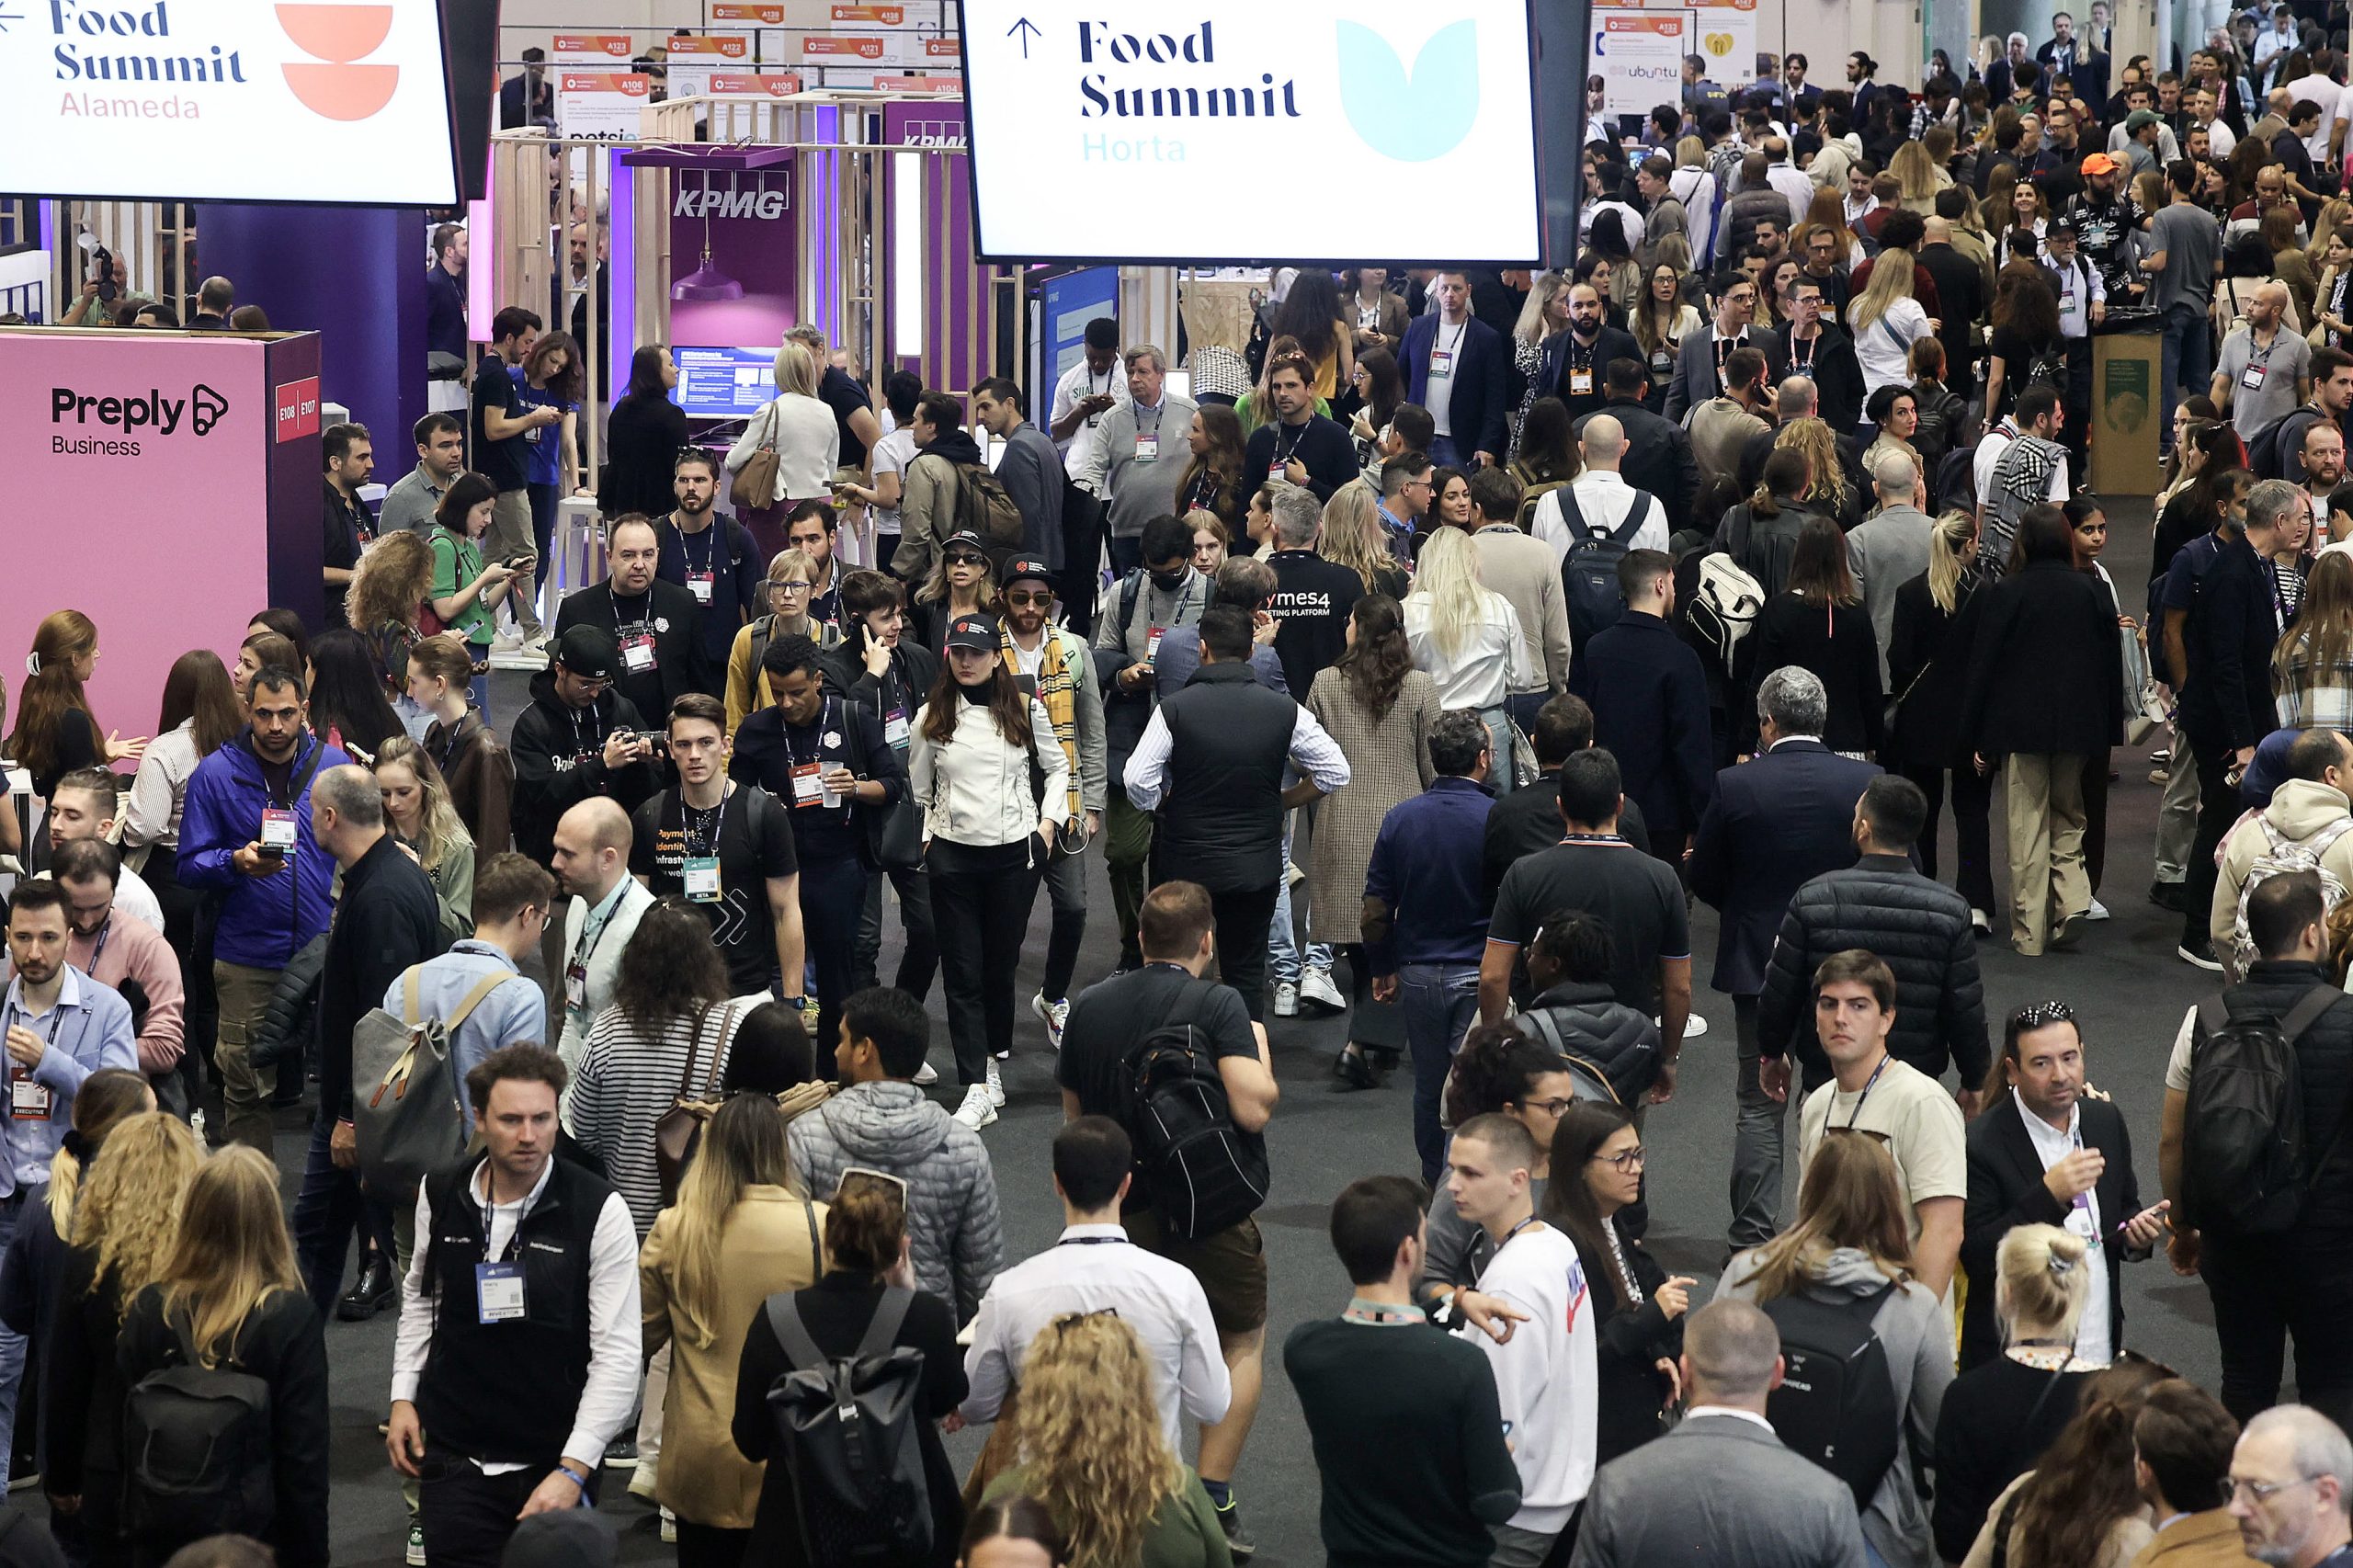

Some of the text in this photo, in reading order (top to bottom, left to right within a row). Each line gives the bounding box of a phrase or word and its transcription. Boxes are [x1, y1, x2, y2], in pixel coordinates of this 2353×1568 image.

[50, 0, 169, 37] Food
[1076, 20, 1214, 62] Food
[53, 43, 248, 83] Summit
[1629, 66, 1677, 79] ubuntu
[60, 92, 200, 119] Alameda
[1080, 73, 1302, 118] Summit
[1083, 132, 1187, 162] Horta
[673, 189, 786, 220] KPMG
[51, 387, 187, 436] Preply
[279, 399, 316, 422] E108 E107
[51, 435, 141, 456] Business
[1267, 592, 1331, 609] ymes4
[1291, 608, 1330, 617] PLATFORM
